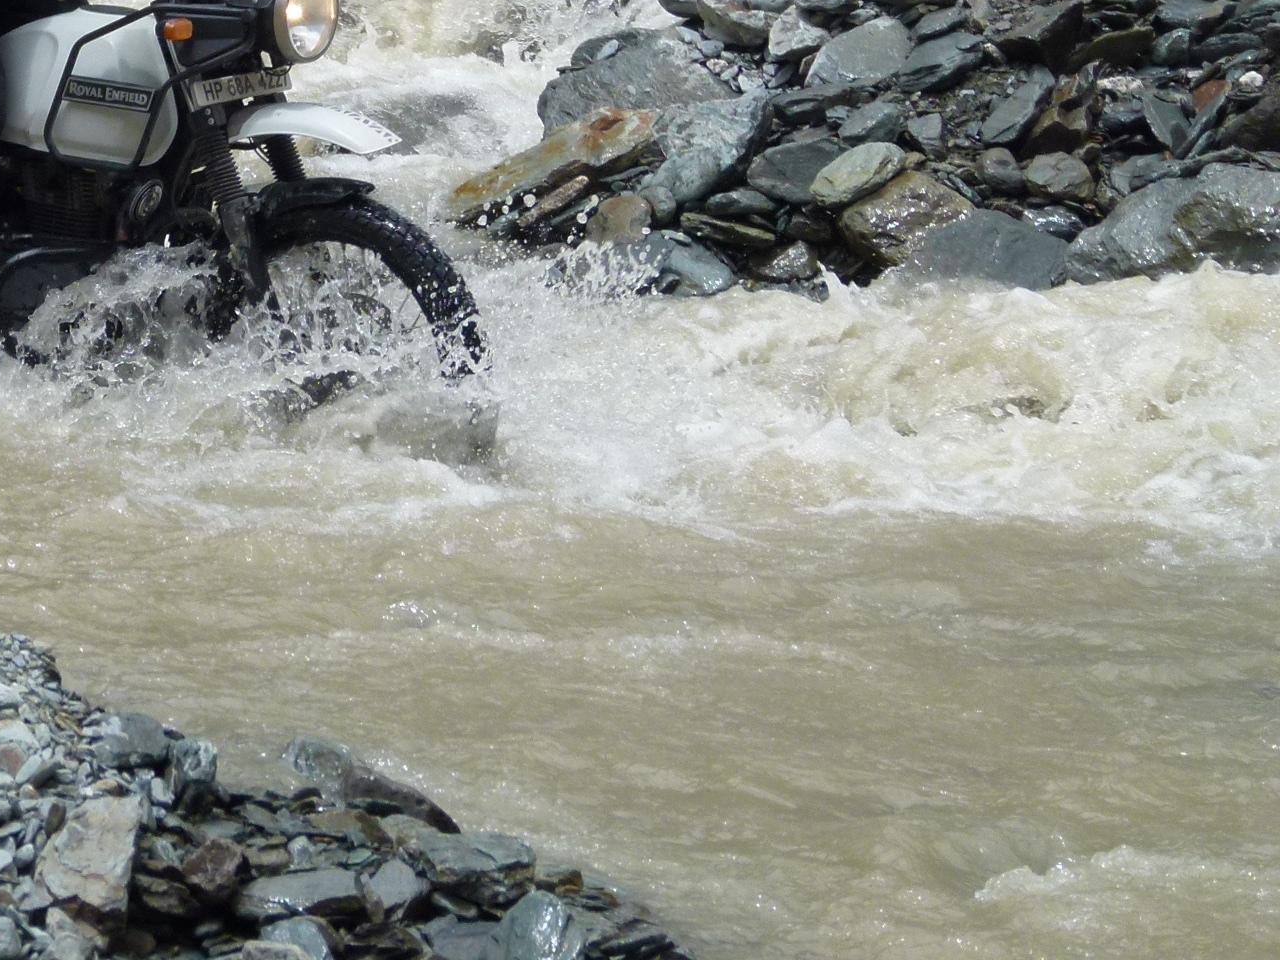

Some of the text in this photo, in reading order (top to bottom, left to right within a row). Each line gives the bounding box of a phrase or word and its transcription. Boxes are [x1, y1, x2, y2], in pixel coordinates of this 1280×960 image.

[68, 81, 148, 106] ROYAL ENFIELD
[202, 81, 223, 102] HP
[227, 76, 255, 97] 68A
